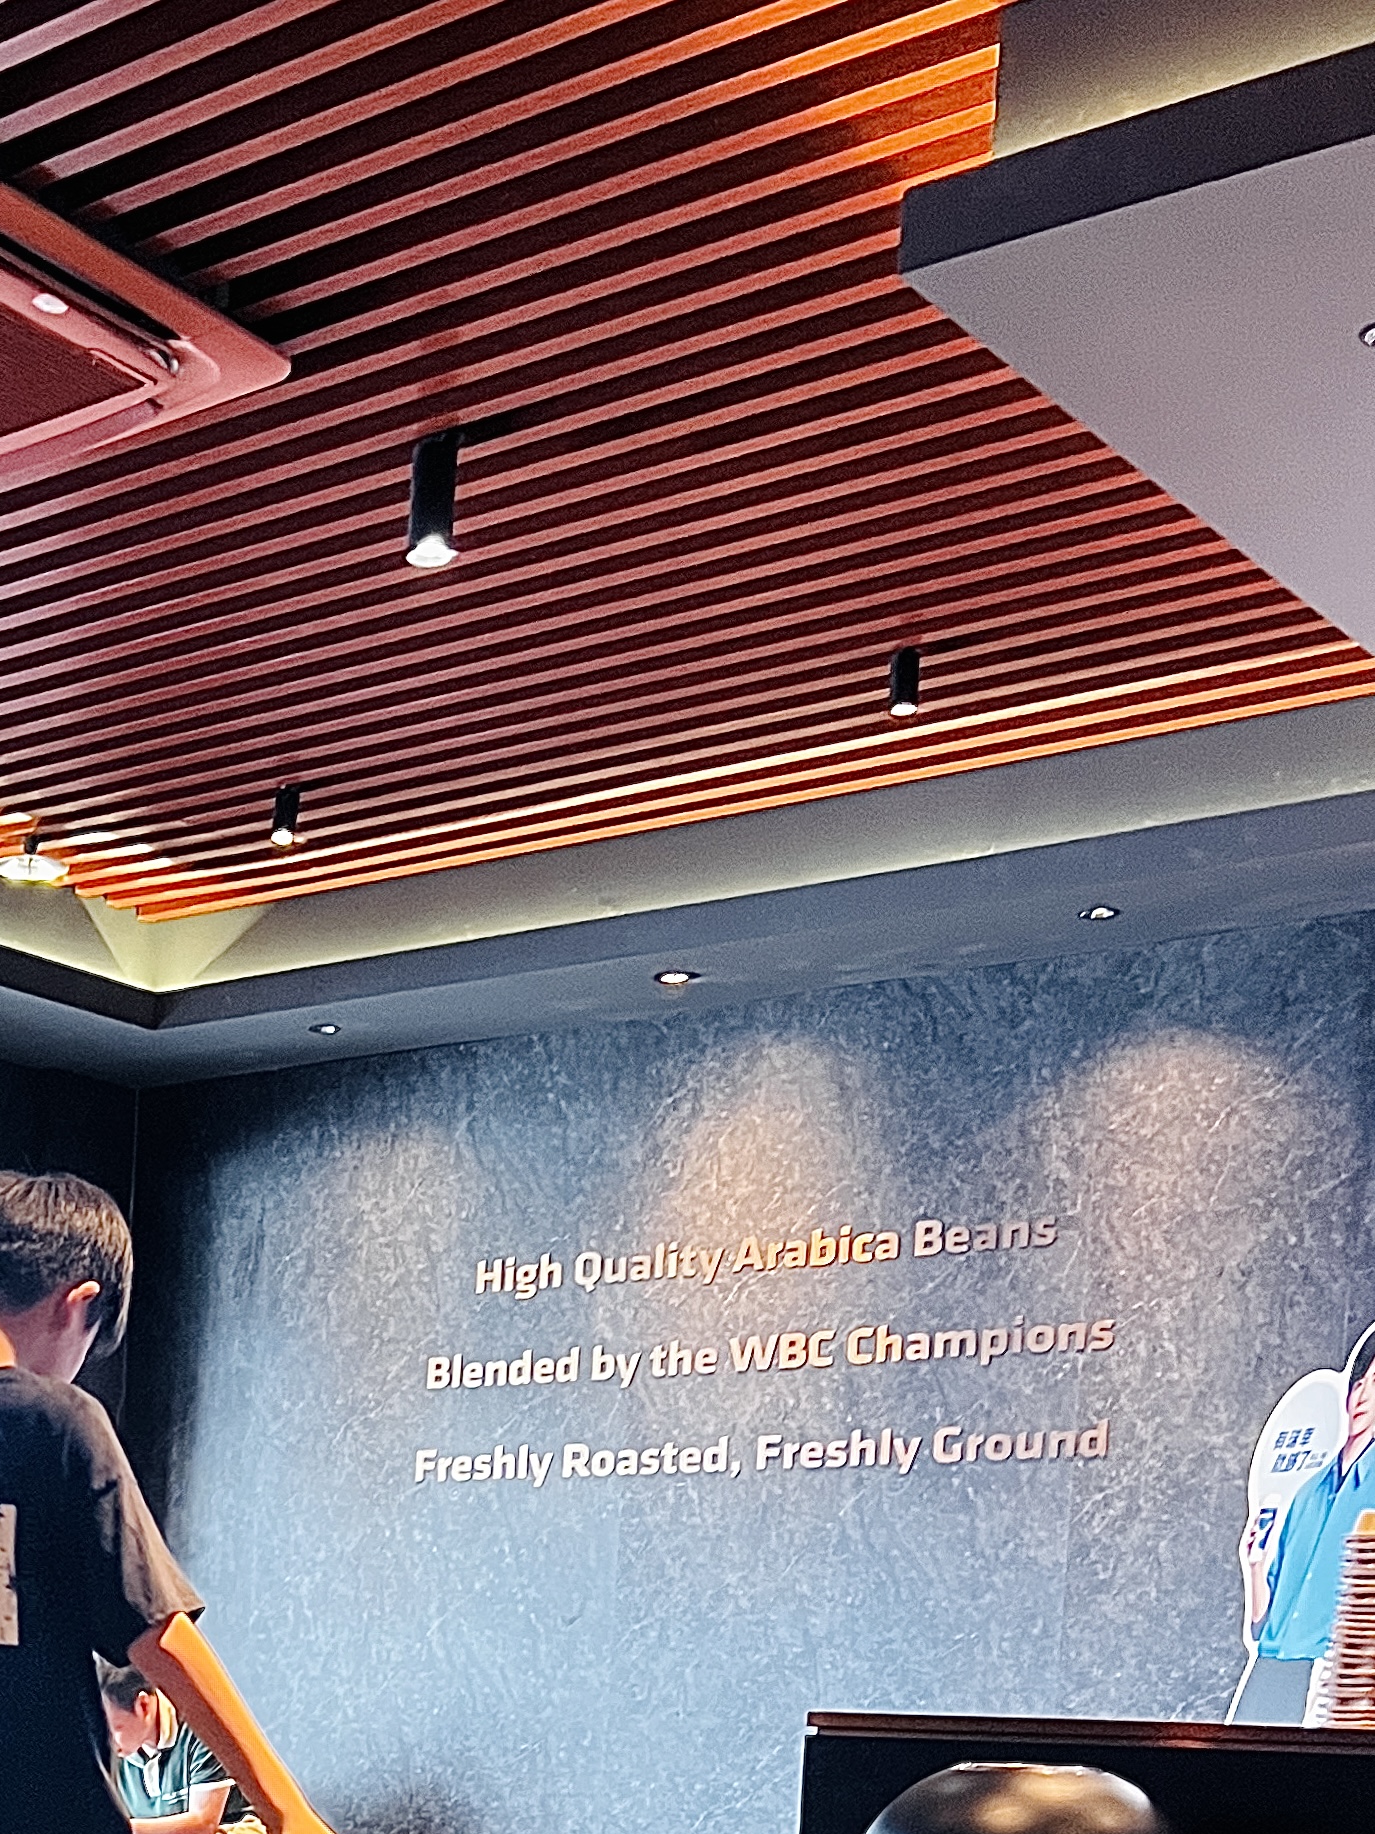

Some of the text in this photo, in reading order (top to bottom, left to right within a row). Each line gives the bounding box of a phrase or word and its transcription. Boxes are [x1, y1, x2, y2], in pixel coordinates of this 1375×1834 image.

[475, 1216, 1059, 1301] High Quality Arabica Beans
[426, 1315, 1116, 1391] Blended by the WBC Champions
[414, 1418, 1110, 1488] Freshly Roasted, Freshly Ground
